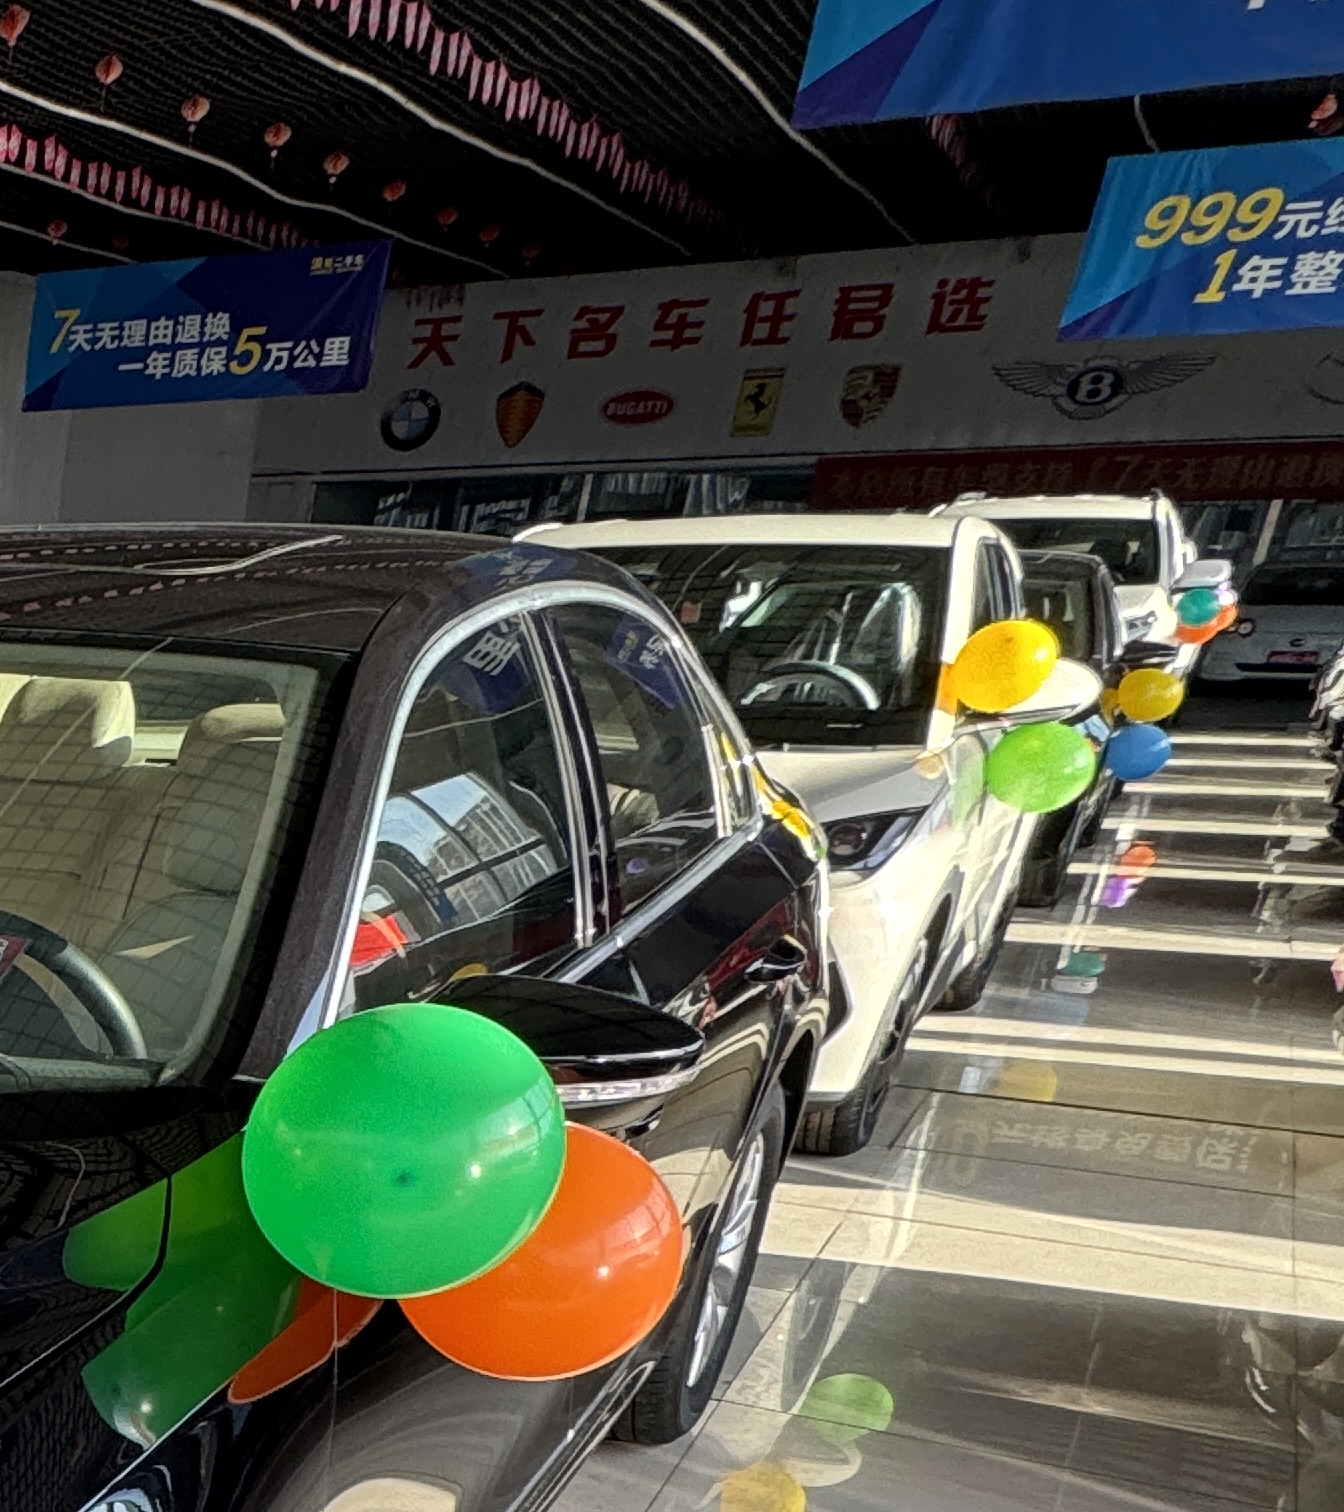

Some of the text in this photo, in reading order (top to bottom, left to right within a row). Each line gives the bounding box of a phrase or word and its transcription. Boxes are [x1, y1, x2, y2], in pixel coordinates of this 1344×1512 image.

[1193, 248, 1344, 304] 1年整
[49, 308, 230, 355] 7天无理由退换
[407, 276, 996, 370] 天下名车任君选
[118, 326, 352, 381] 一年质保5万公里
[607, 401, 668, 417] BUGATTI
